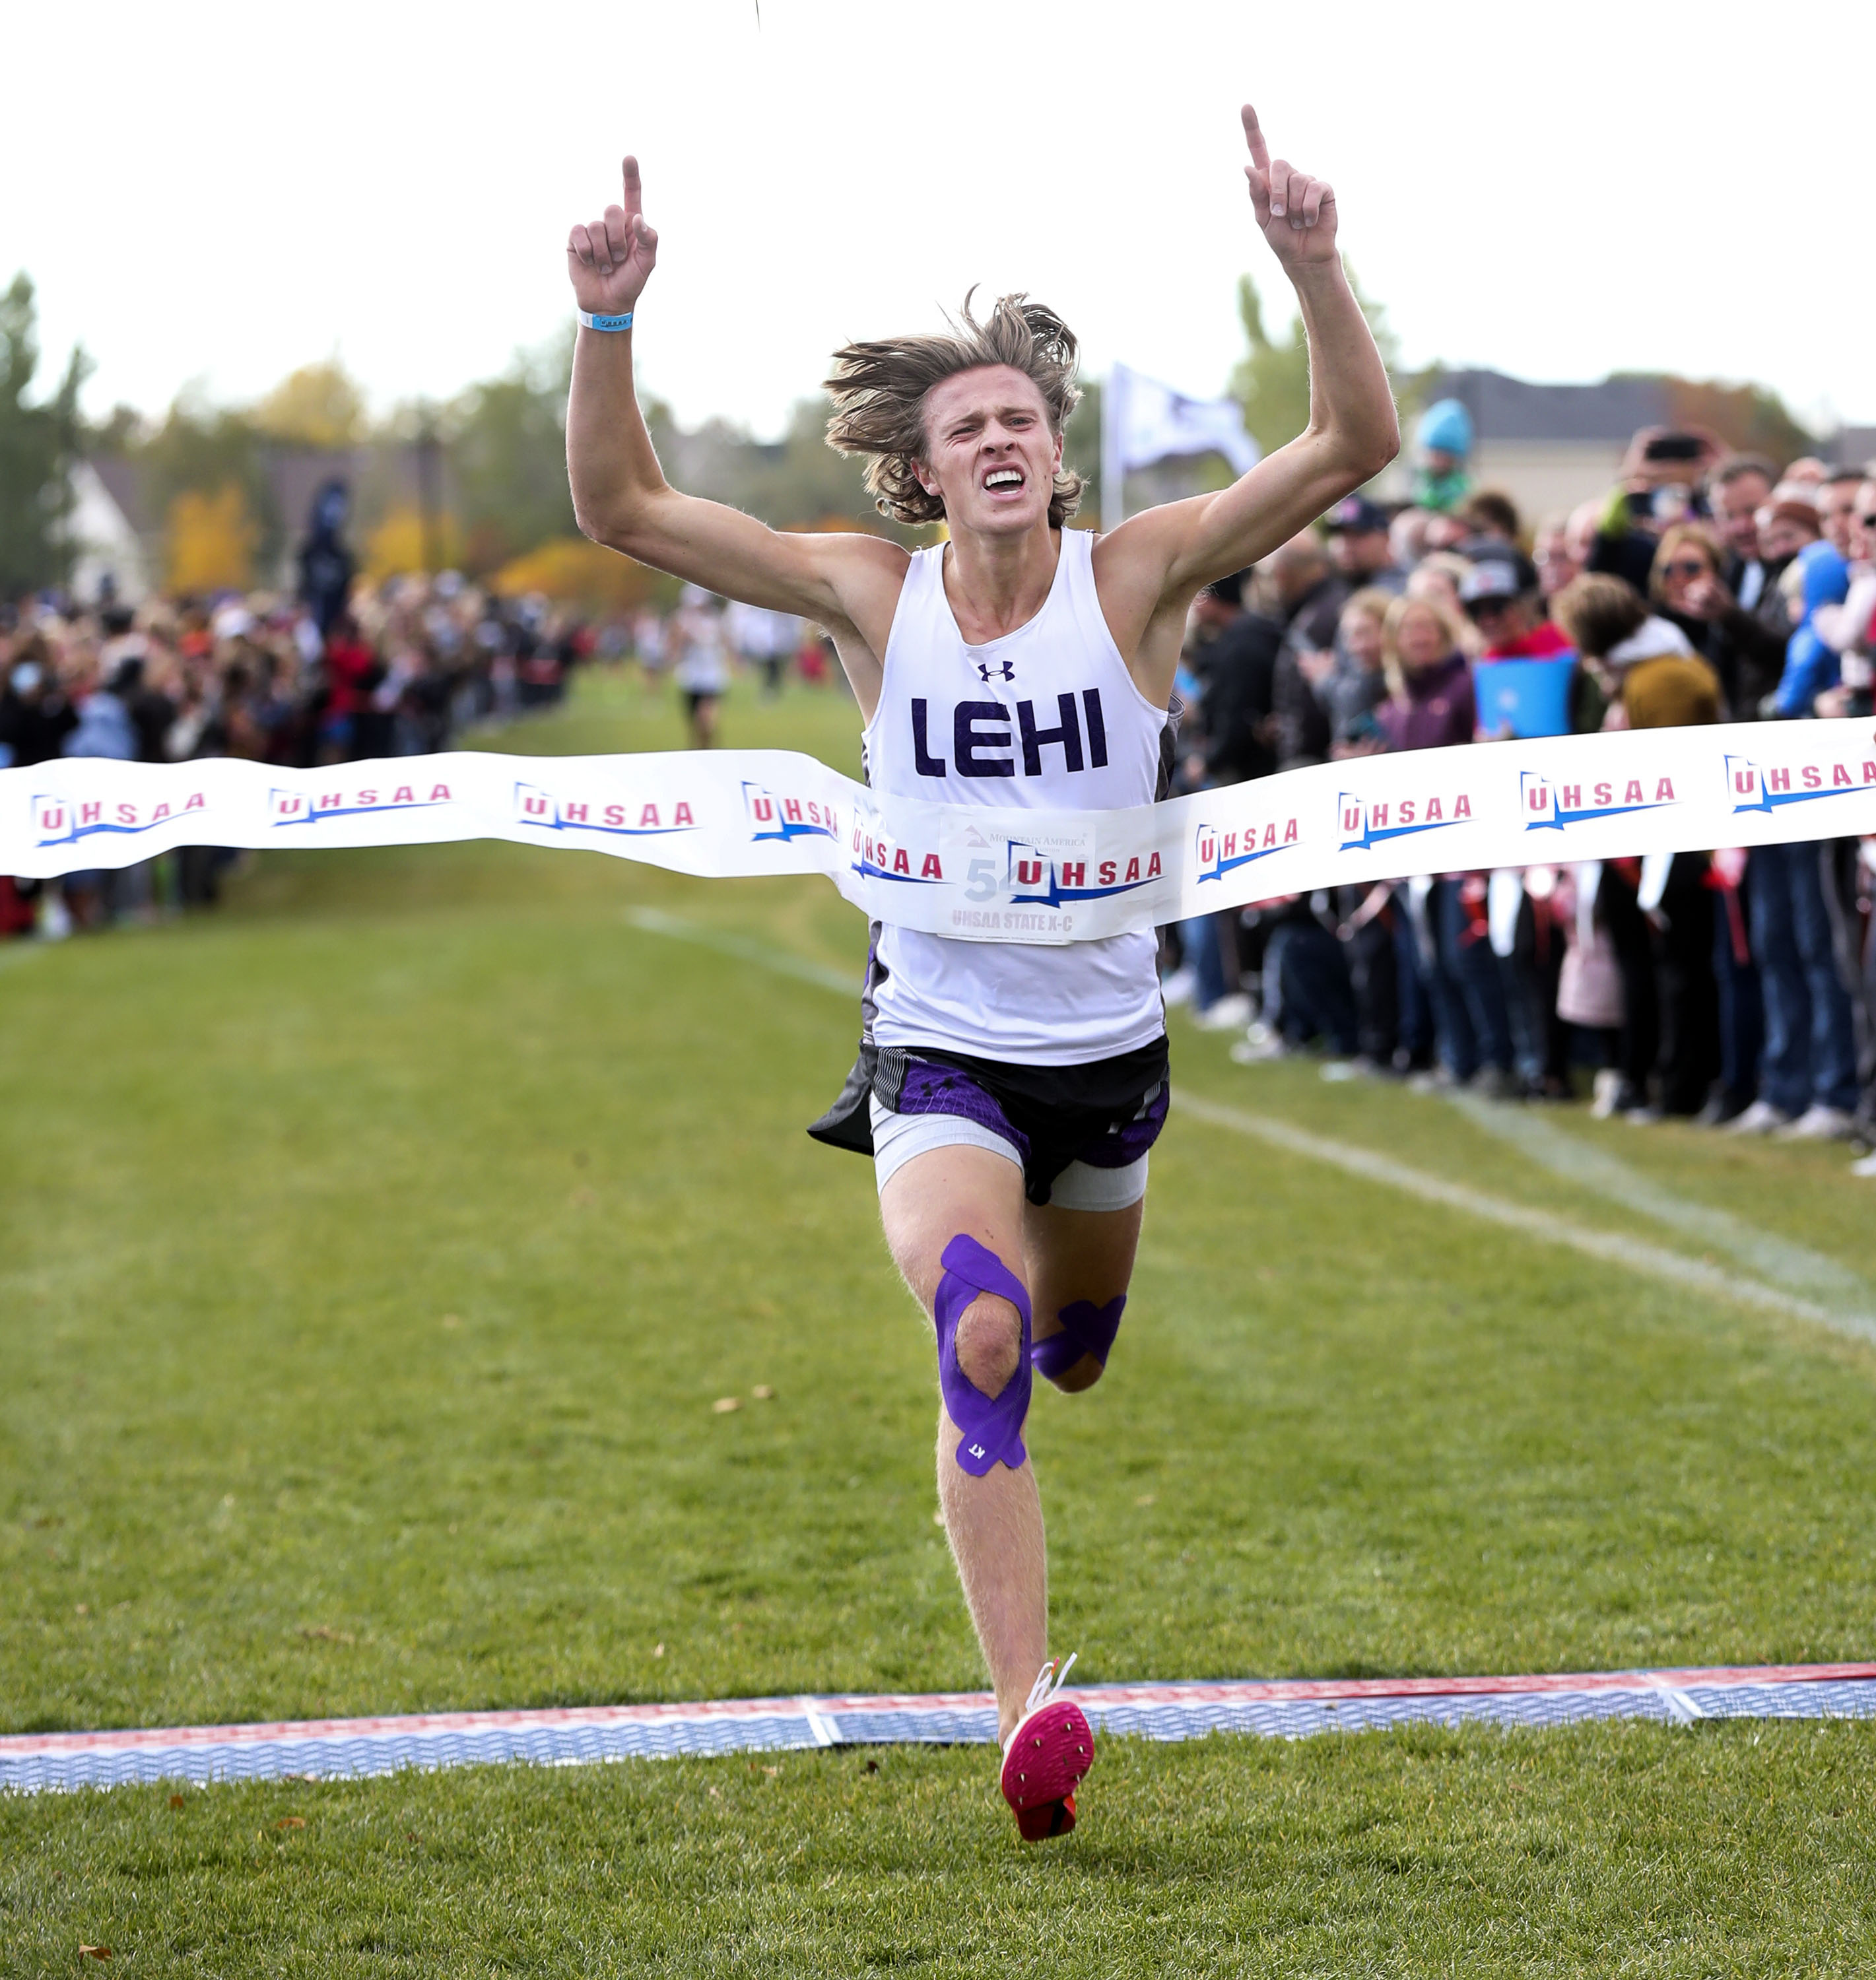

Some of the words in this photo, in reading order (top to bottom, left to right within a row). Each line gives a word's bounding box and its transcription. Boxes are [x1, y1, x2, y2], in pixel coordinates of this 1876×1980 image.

[912, 688, 1108, 777] LEHI
[42, 793, 206, 830] UHSAA
[279, 783, 452, 814] UHSAA
[524, 796, 695, 826] UHSAA
[1529, 777, 1675, 810] UHSAA
[753, 798, 838, 838] UHSAA
[1344, 794, 1472, 831] UHSAA
[853, 828, 943, 879] UHSAA
[1201, 818, 1298, 863] UHSAA
[1018, 851, 1162, 886] UHSAA
[952, 909, 1000, 929] UHSAA
[1003, 912, 1046, 931] STATE
[1048, 915, 1073, 932] X-C
